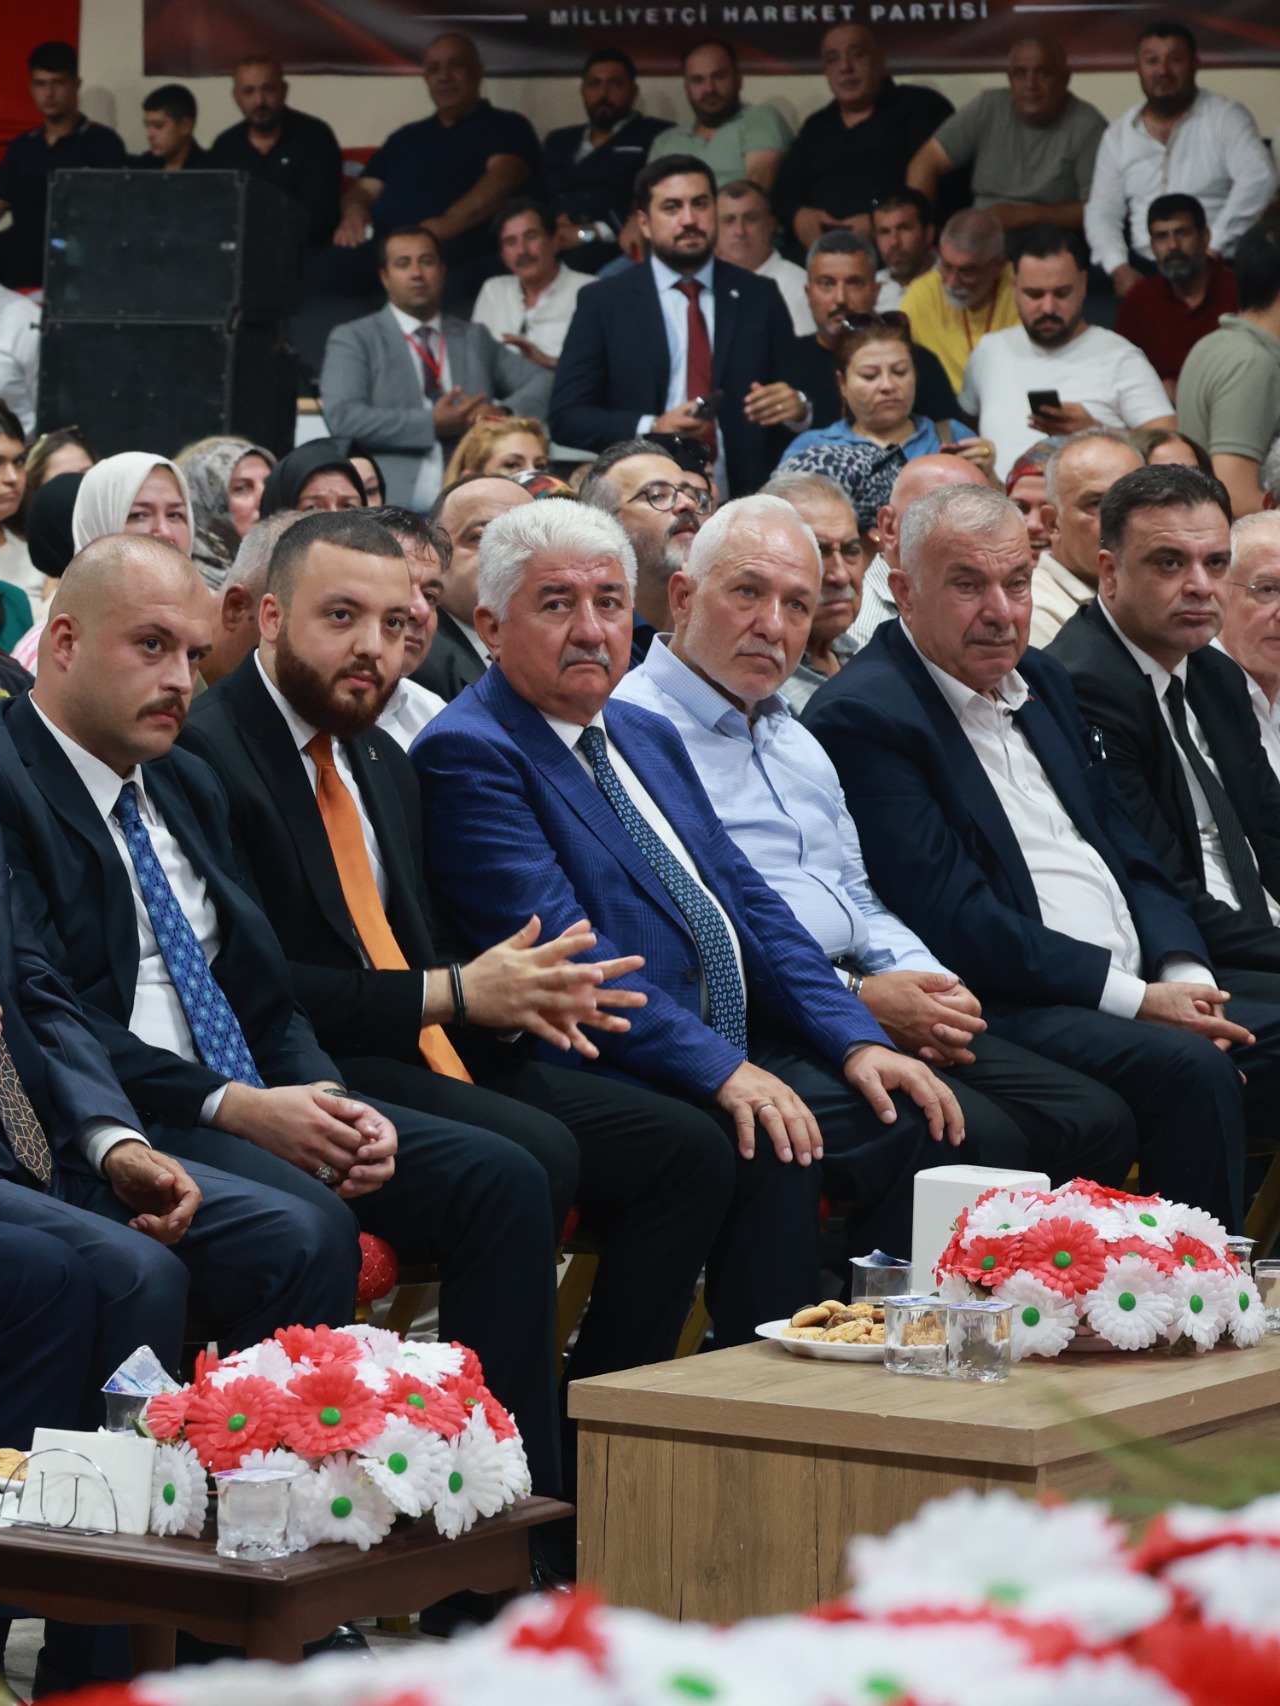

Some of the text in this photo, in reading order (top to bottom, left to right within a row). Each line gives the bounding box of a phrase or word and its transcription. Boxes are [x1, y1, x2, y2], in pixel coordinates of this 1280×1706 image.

[549, 0, 989, 26] MİLLİYETÇİ HAREKET PARTİSİ
